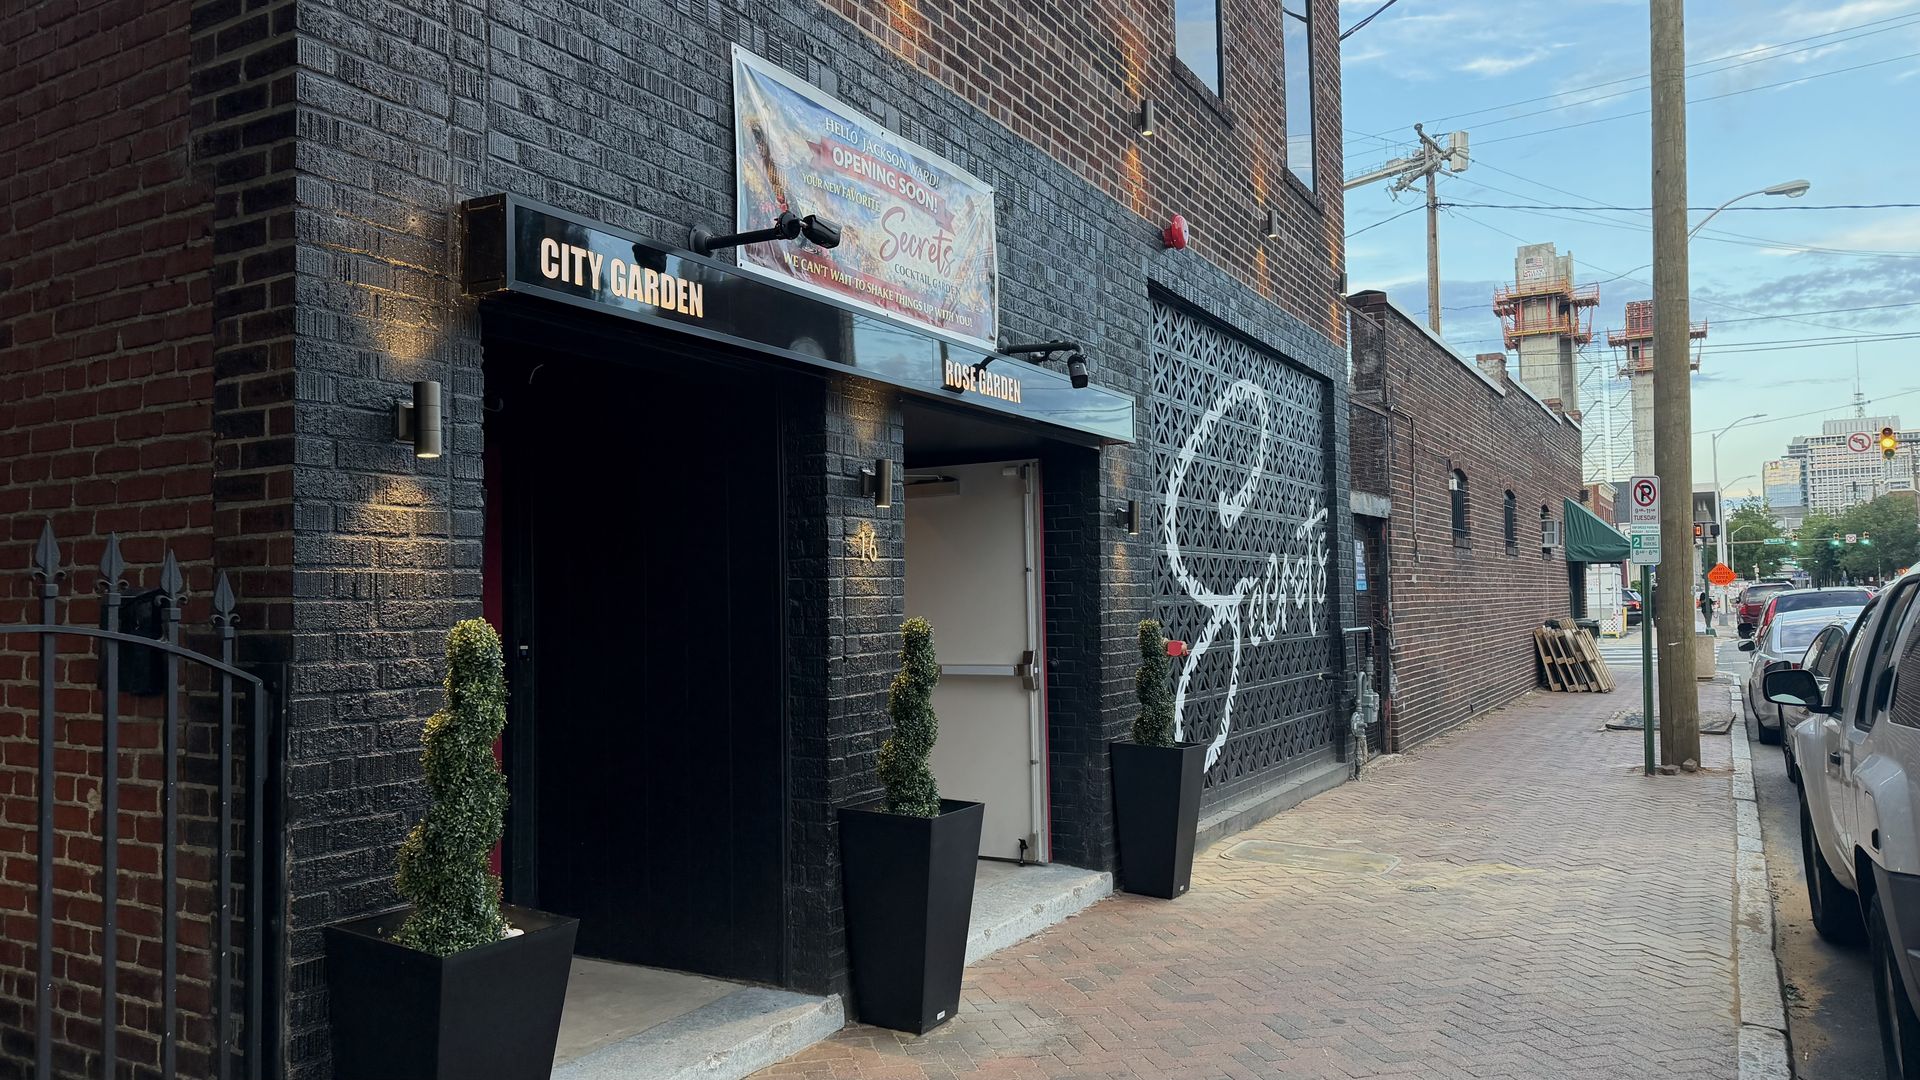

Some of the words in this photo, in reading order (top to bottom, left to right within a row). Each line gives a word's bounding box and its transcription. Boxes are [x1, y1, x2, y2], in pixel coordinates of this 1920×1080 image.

[825, 117, 858, 144] HELLO
[862, 137, 908, 171] JACKSON
[908, 162, 940, 189] WARD!
[832, 146, 897, 189] OPENING
[899, 178, 938, 212] SOON!
[802, 174, 822, 189] YOUR
[823, 181, 841, 195] NEW
[842, 186, 881, 212] FAVORITE
[880, 206, 956, 278] Secrets
[540, 237, 604, 291] CITY
[610, 258, 704, 319] GARDEN
[783, 250, 799, 268] WE
[801, 258, 828, 277] CAN'T
[830, 268, 853, 287] WAIT
[854, 278, 866, 291] TO
[867, 282, 894, 301] SHAKE
[895, 292, 923, 311] THINGS
[924, 302, 934, 315] UP
[934, 307, 954, 322] WITH
[955, 313, 973, 328] YOU!
[894, 263, 931, 286] COCKTAIL
[932, 278, 961, 296] GARDEN
[945, 359, 977, 392] ROSE
[978, 368, 1022, 404] GARDEN
[859, 531, 877, 562] 16
[1633, 537, 1640, 548] 2
